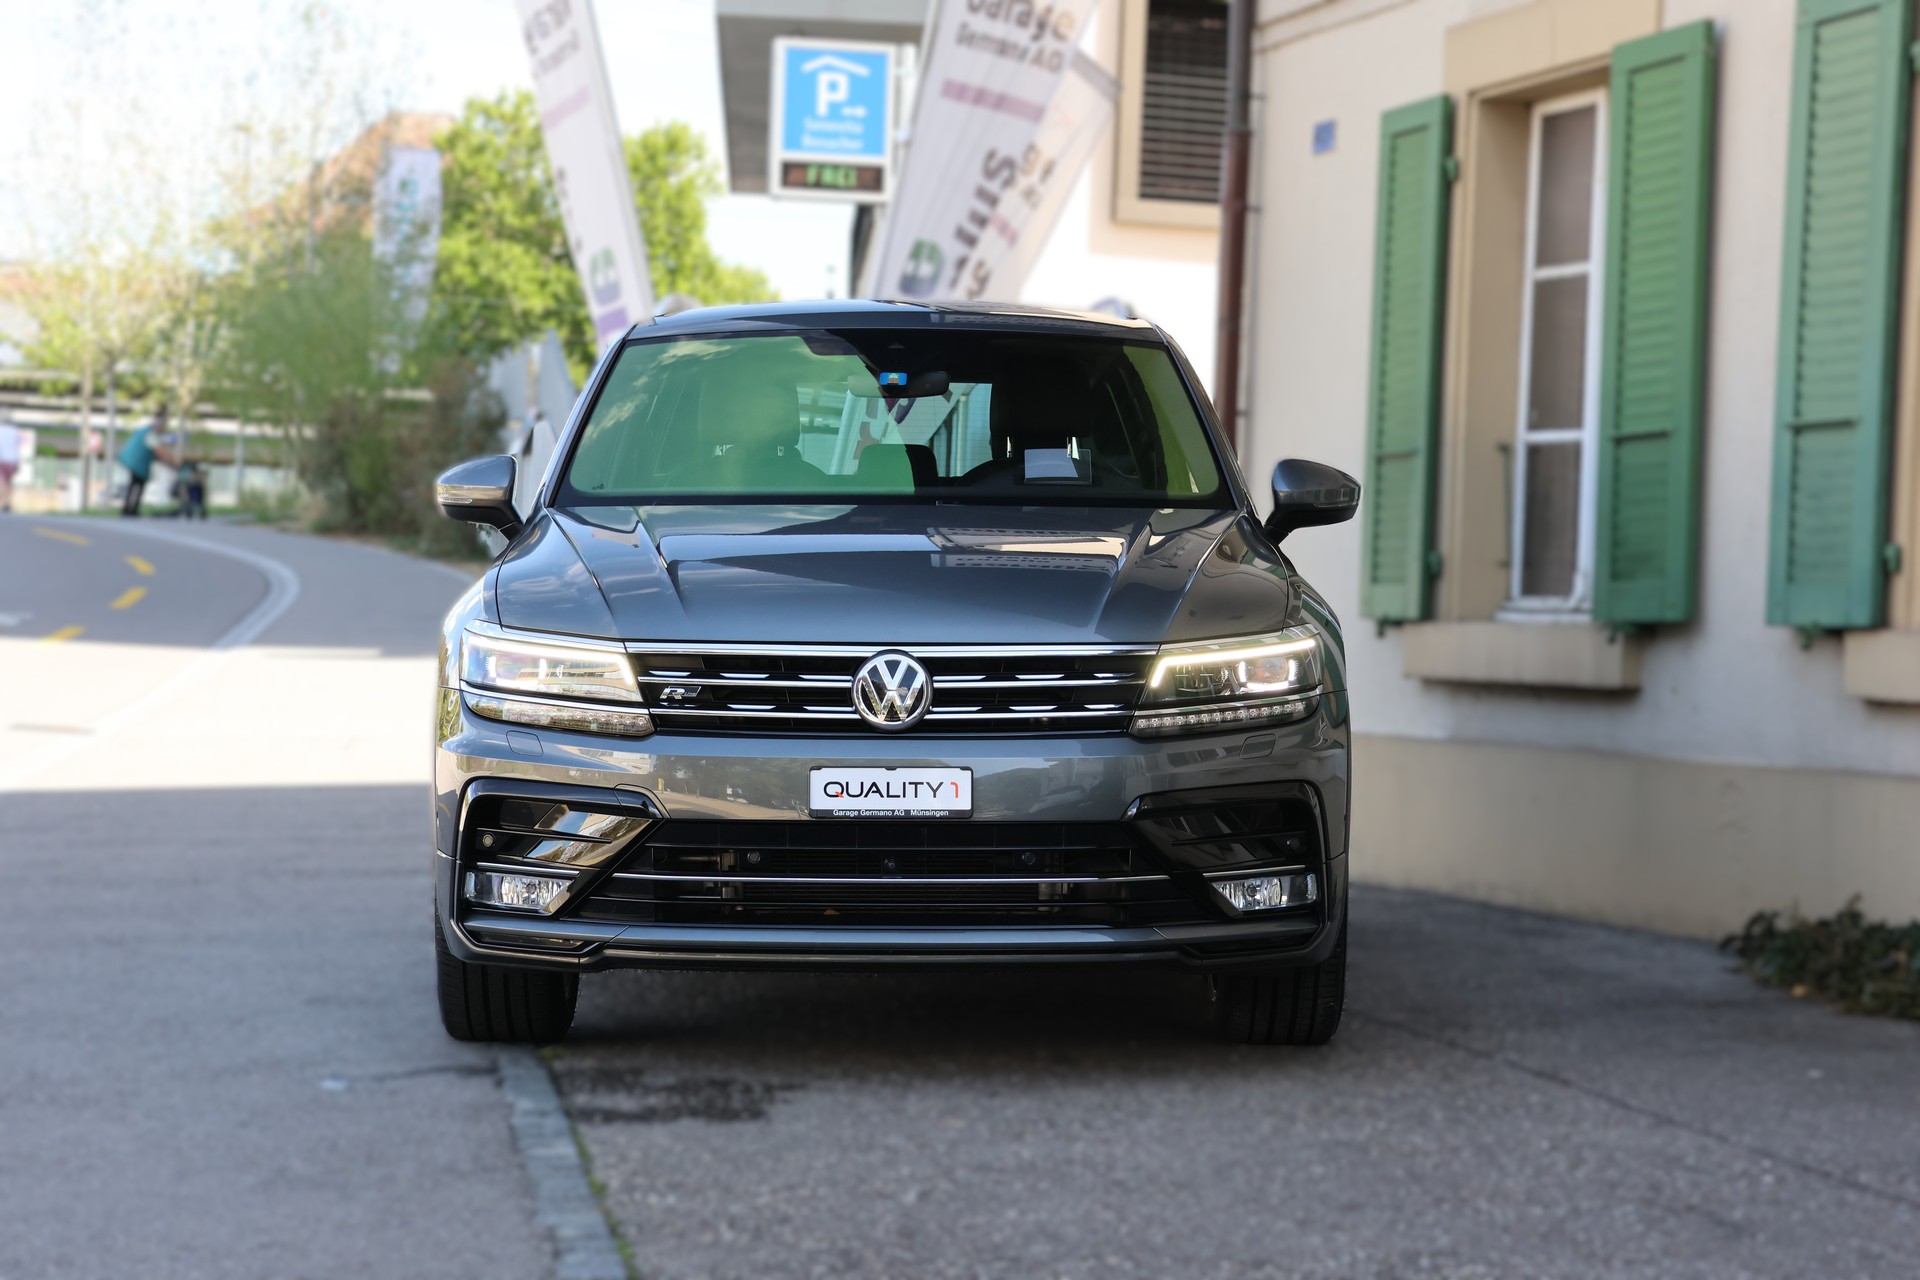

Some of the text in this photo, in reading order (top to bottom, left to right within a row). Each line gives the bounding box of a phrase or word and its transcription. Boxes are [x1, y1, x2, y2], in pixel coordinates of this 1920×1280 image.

[817, 72, 848, 116] P
[857, 653, 928, 726] VW
[823, 781, 944, 798] QUALITY
[833, 809, 858, 817] Garage
[910, 809, 949, 817] Münsingen
